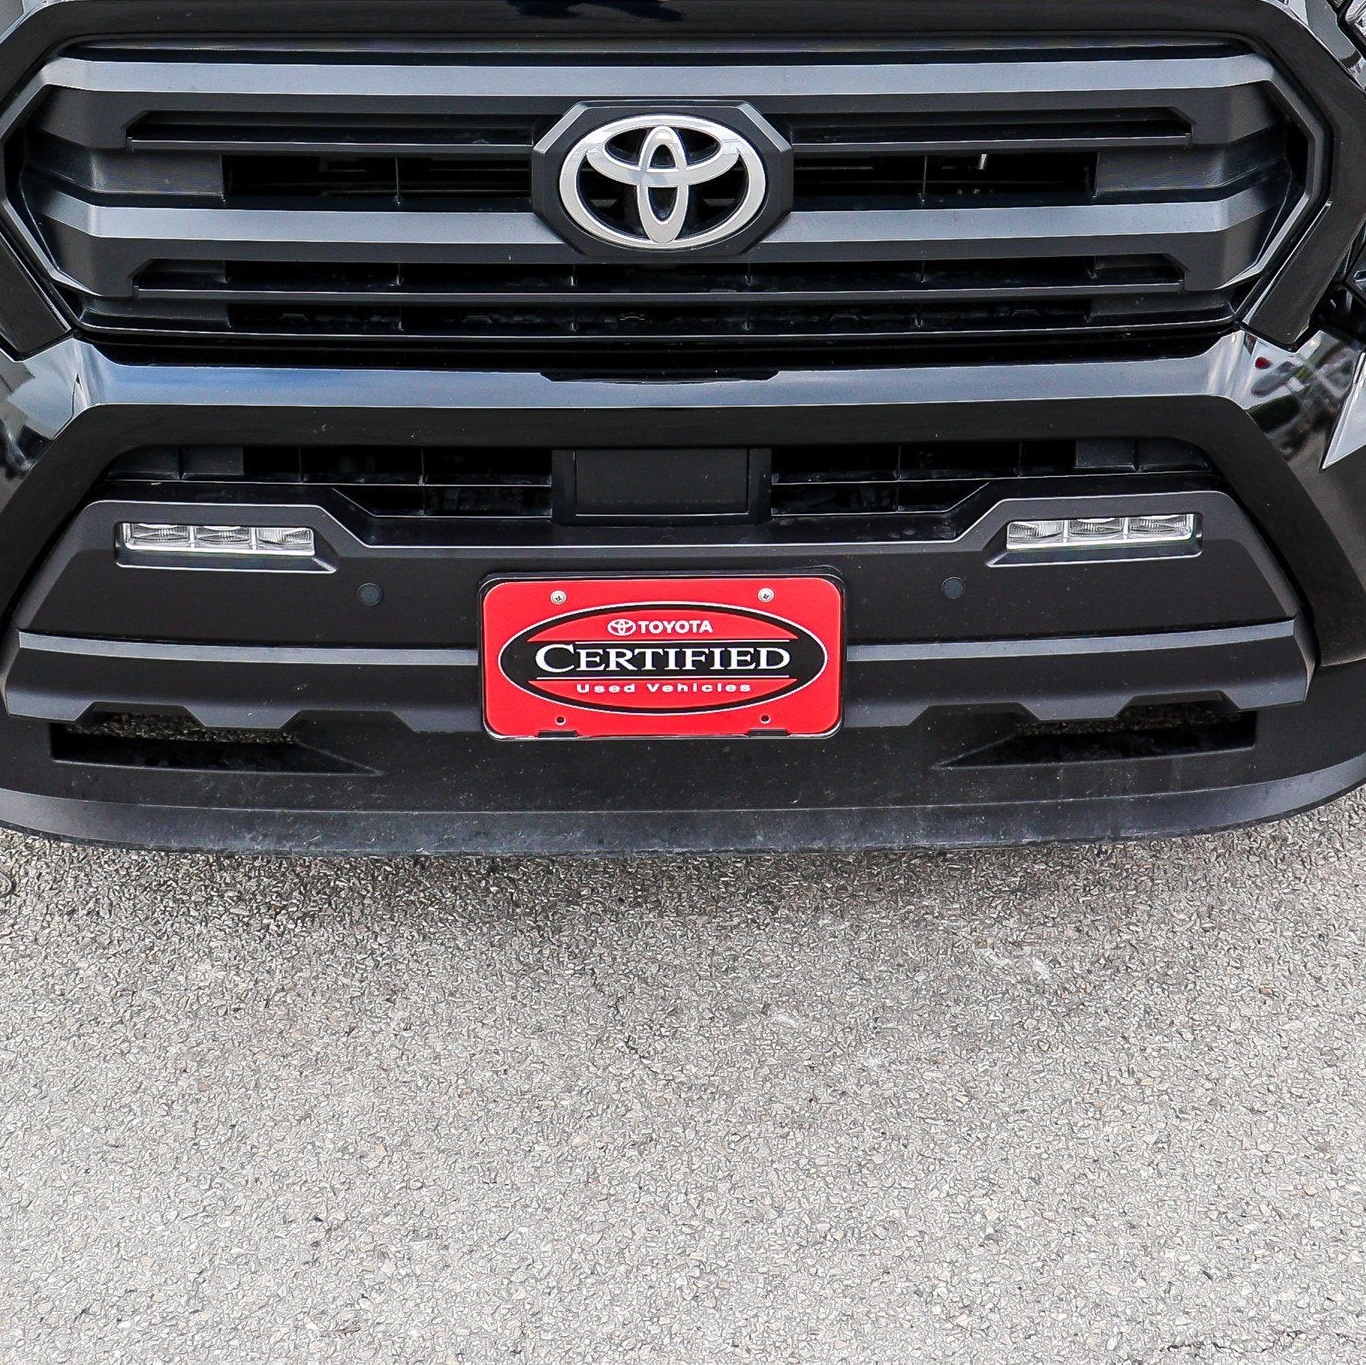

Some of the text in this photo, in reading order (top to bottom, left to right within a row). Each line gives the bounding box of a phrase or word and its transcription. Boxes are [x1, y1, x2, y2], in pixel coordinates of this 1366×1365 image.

[638, 620, 713, 634] TOYOTA
[576, 683, 752, 693] Used Vehicles
